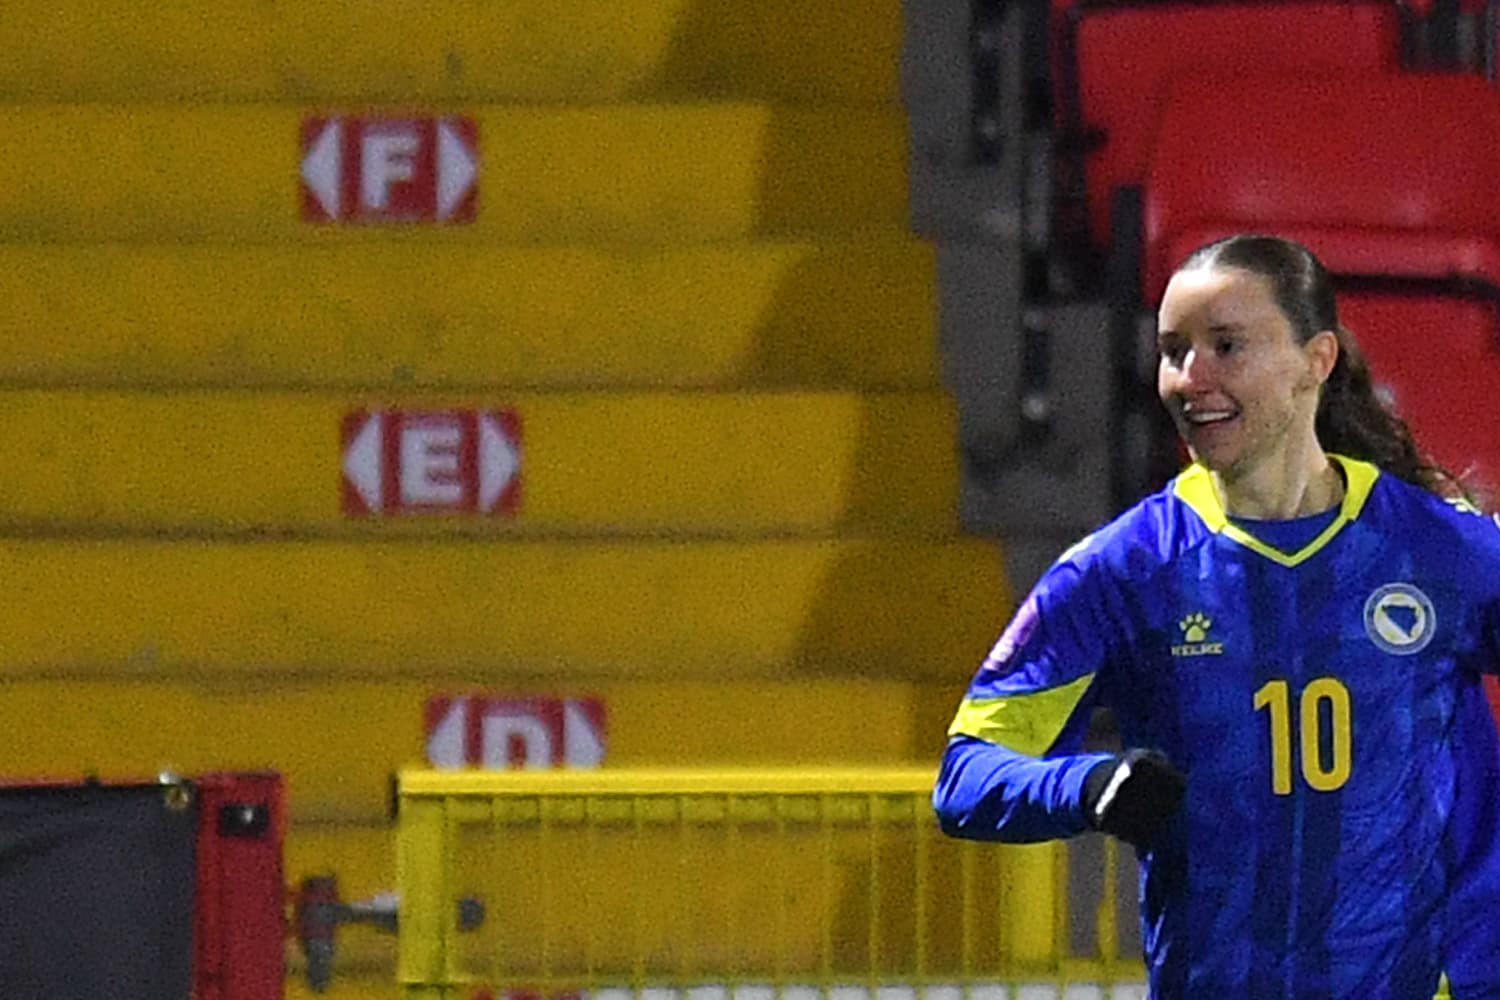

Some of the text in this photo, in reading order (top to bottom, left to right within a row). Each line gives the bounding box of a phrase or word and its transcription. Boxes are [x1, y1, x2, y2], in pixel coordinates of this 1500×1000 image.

[361, 130, 420, 209] F
[401, 426, 464, 504] E
[481, 714, 552, 768] D
[1253, 677, 1352, 795] 10
